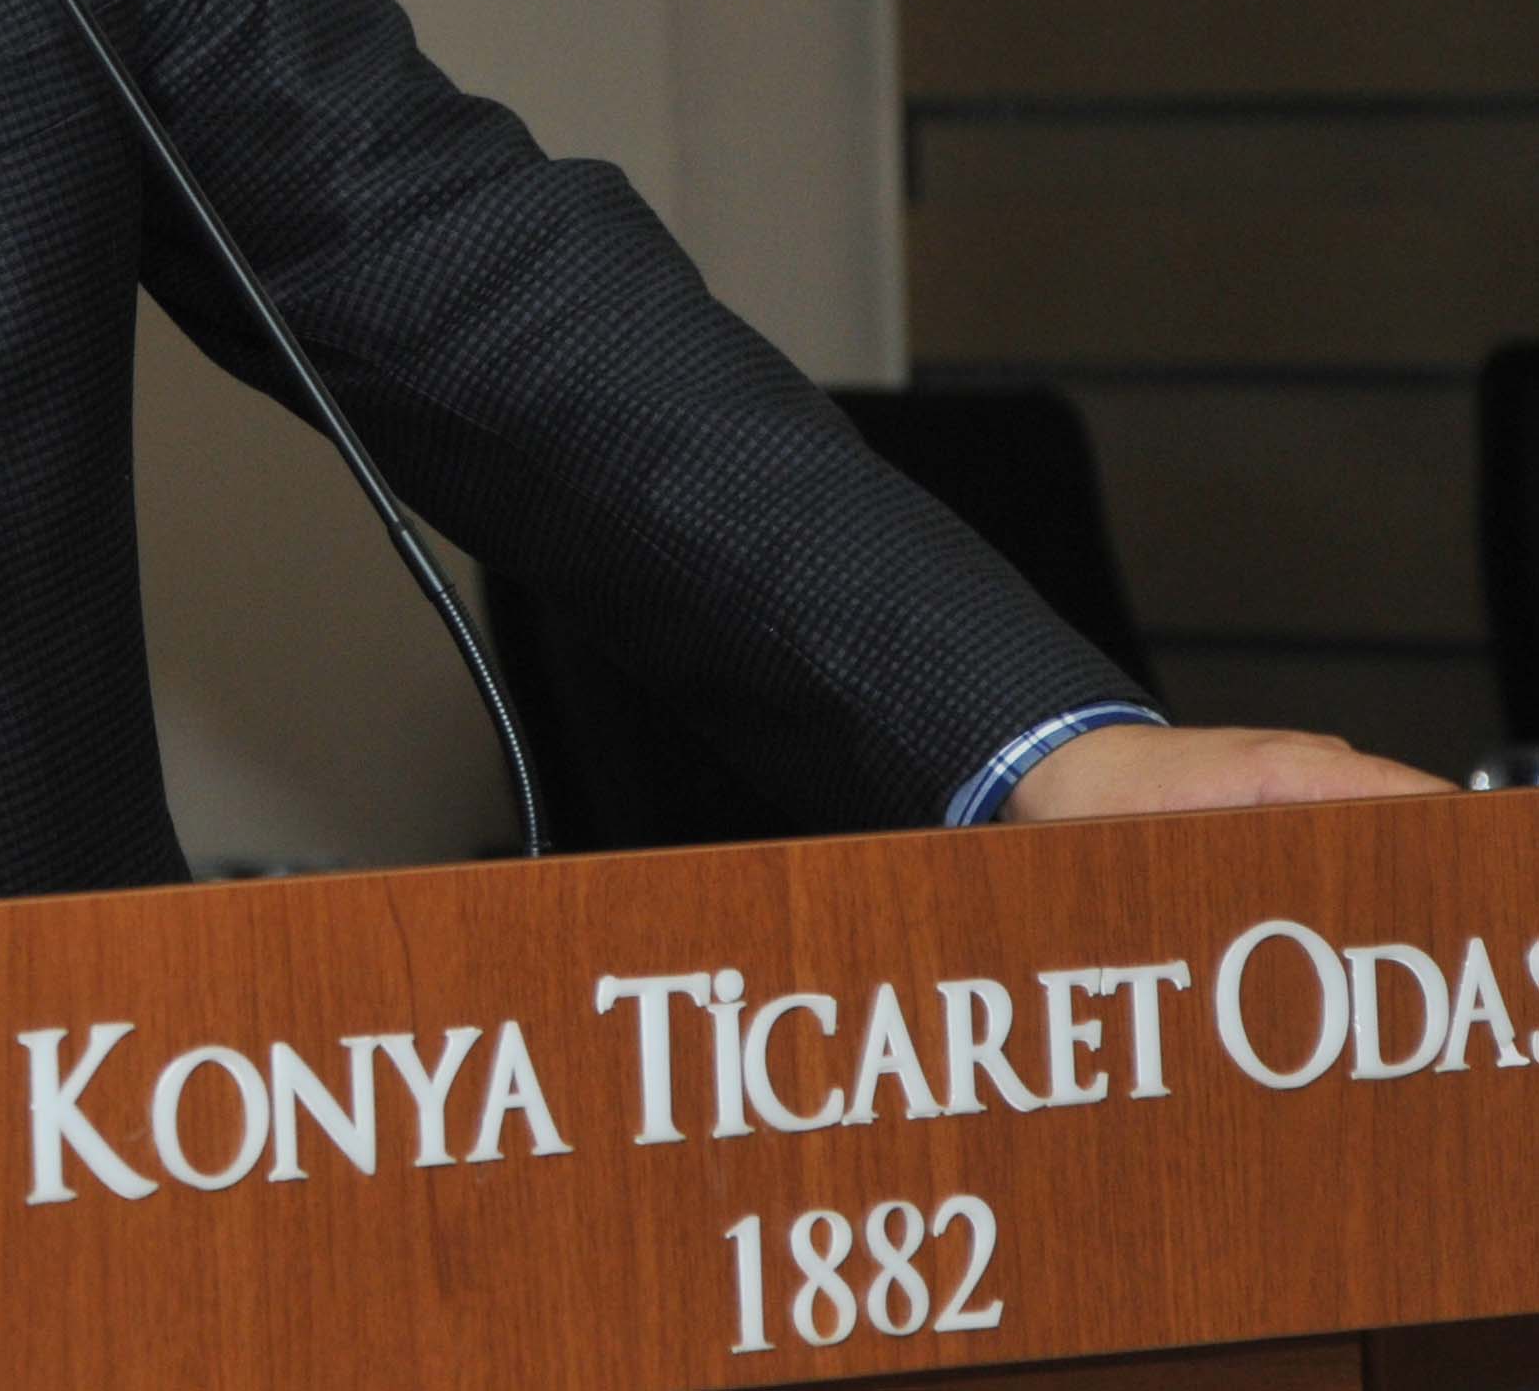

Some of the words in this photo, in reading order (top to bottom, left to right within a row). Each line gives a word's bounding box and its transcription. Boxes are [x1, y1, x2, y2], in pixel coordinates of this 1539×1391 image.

[17, 1019, 574, 1206] KONYA
[1214, 919, 1539, 1090] ODA
[724, 1194, 1004, 1355] 1882
